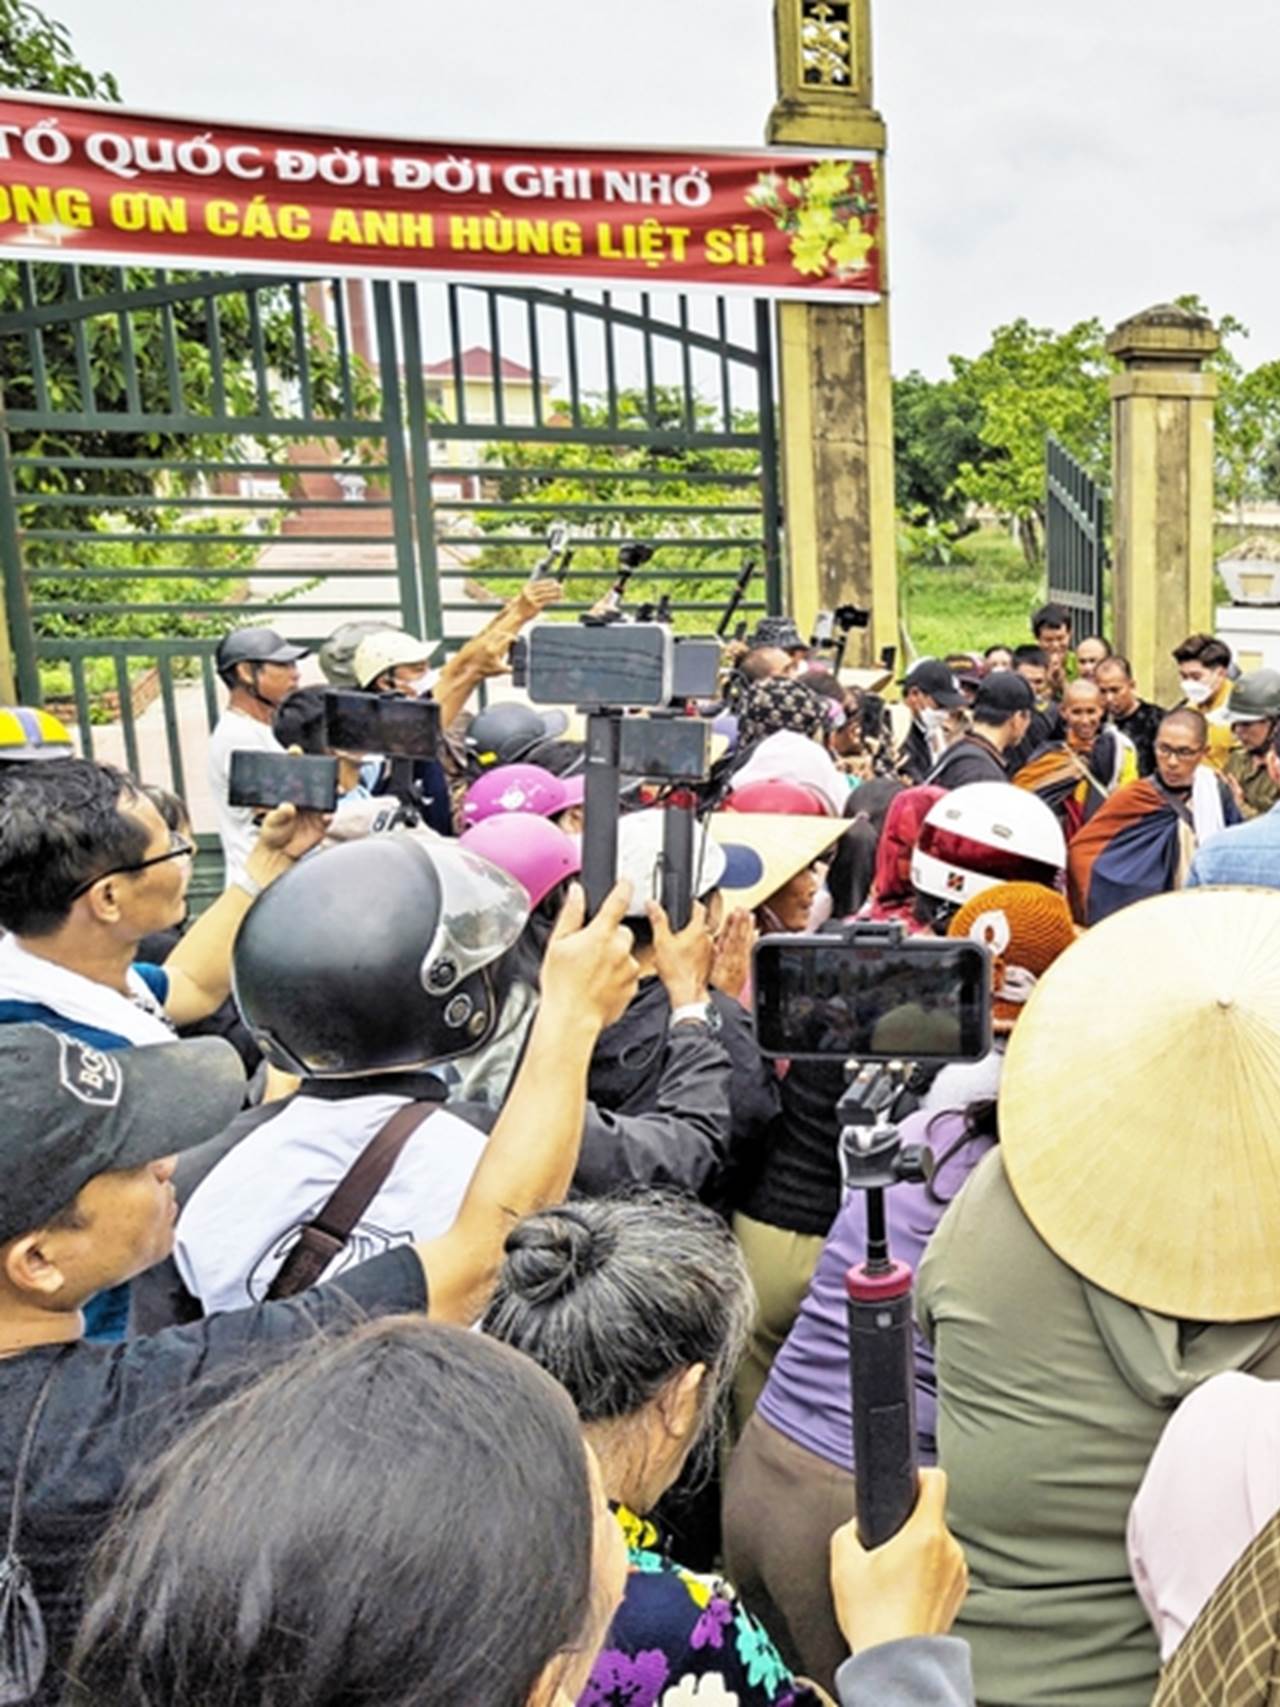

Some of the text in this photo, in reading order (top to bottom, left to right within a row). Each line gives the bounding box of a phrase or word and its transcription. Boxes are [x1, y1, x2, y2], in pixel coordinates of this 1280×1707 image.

[85, 131, 262, 180] QUỐC
[275, 146, 380, 187] ĐỜI
[390, 153, 493, 195] ĐỜI
[502, 163, 592, 200] GHI
[603, 166, 712, 207] NHỚ
[110, 191, 188, 233] ƠN
[205, 195, 311, 241] CÁC
[328, 208, 434, 249] ANH
[449, 211, 582, 257] HÙNG
[597, 218, 690, 268] LIỆT
[704, 224, 766, 266] SĨ!
